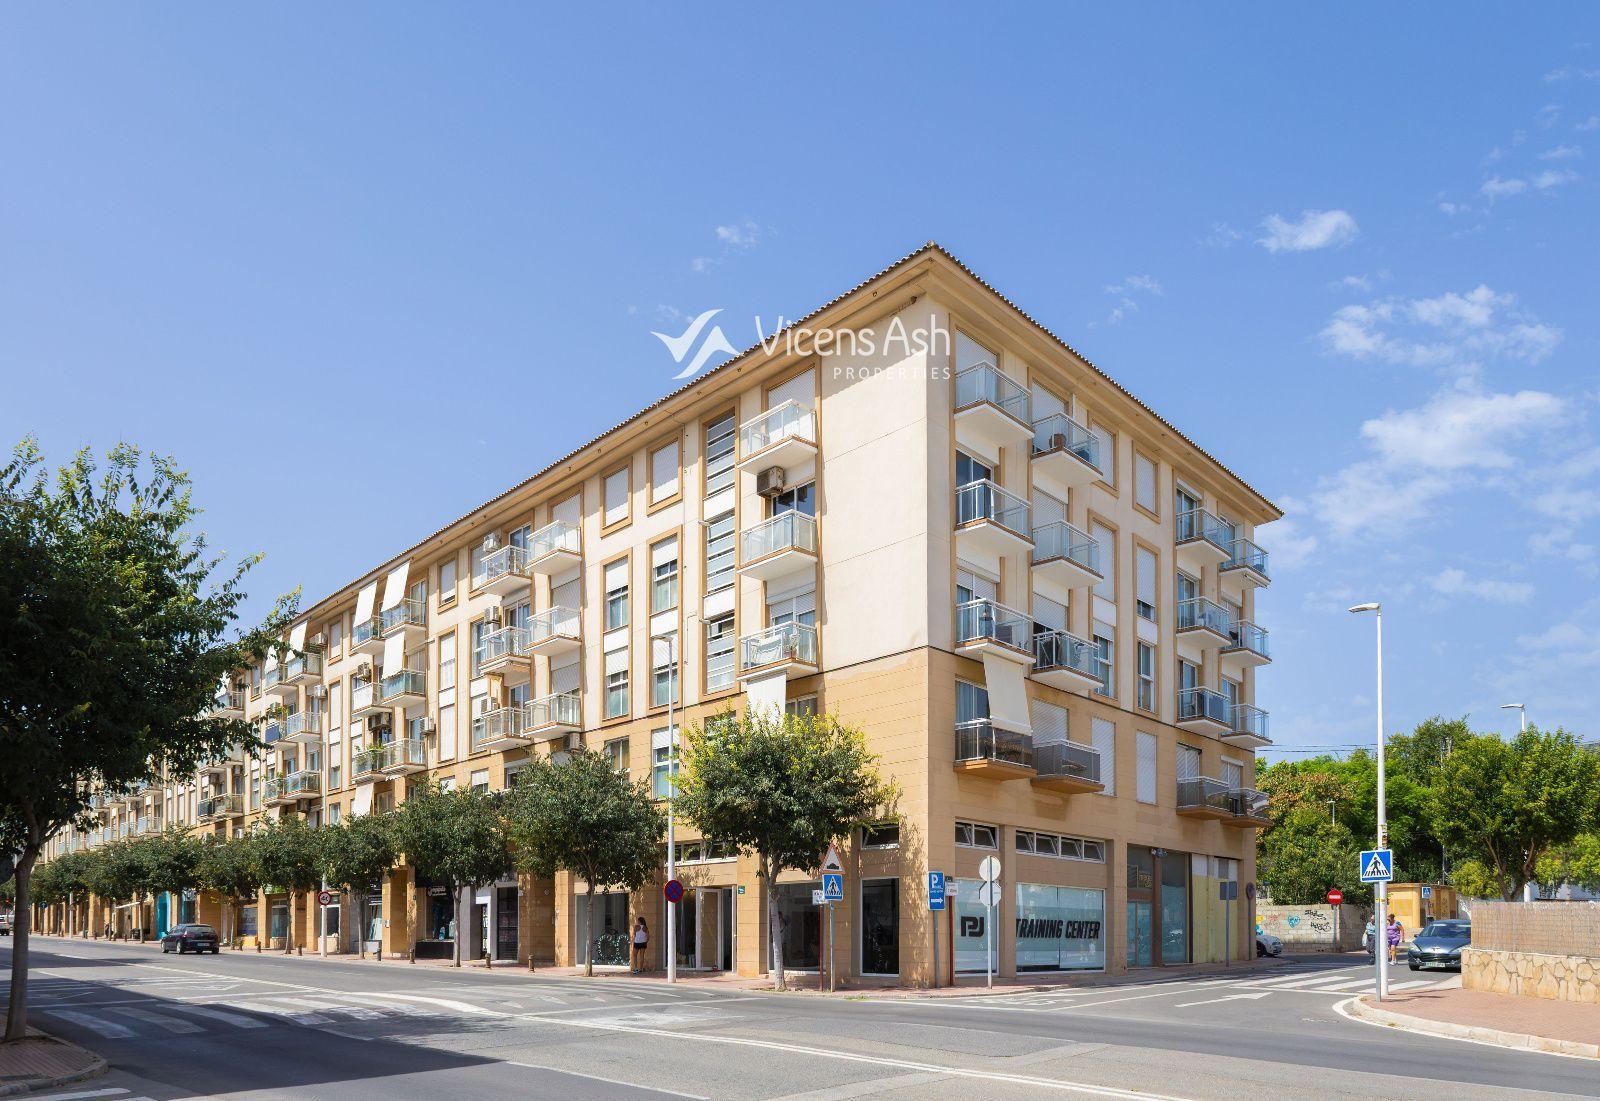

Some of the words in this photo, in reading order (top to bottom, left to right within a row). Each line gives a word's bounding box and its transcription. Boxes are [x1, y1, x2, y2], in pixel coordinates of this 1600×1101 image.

[931, 874, 939, 888] P
[1016, 918, 1063, 938] TRAINING
[1065, 920, 1100, 939] CENTER
